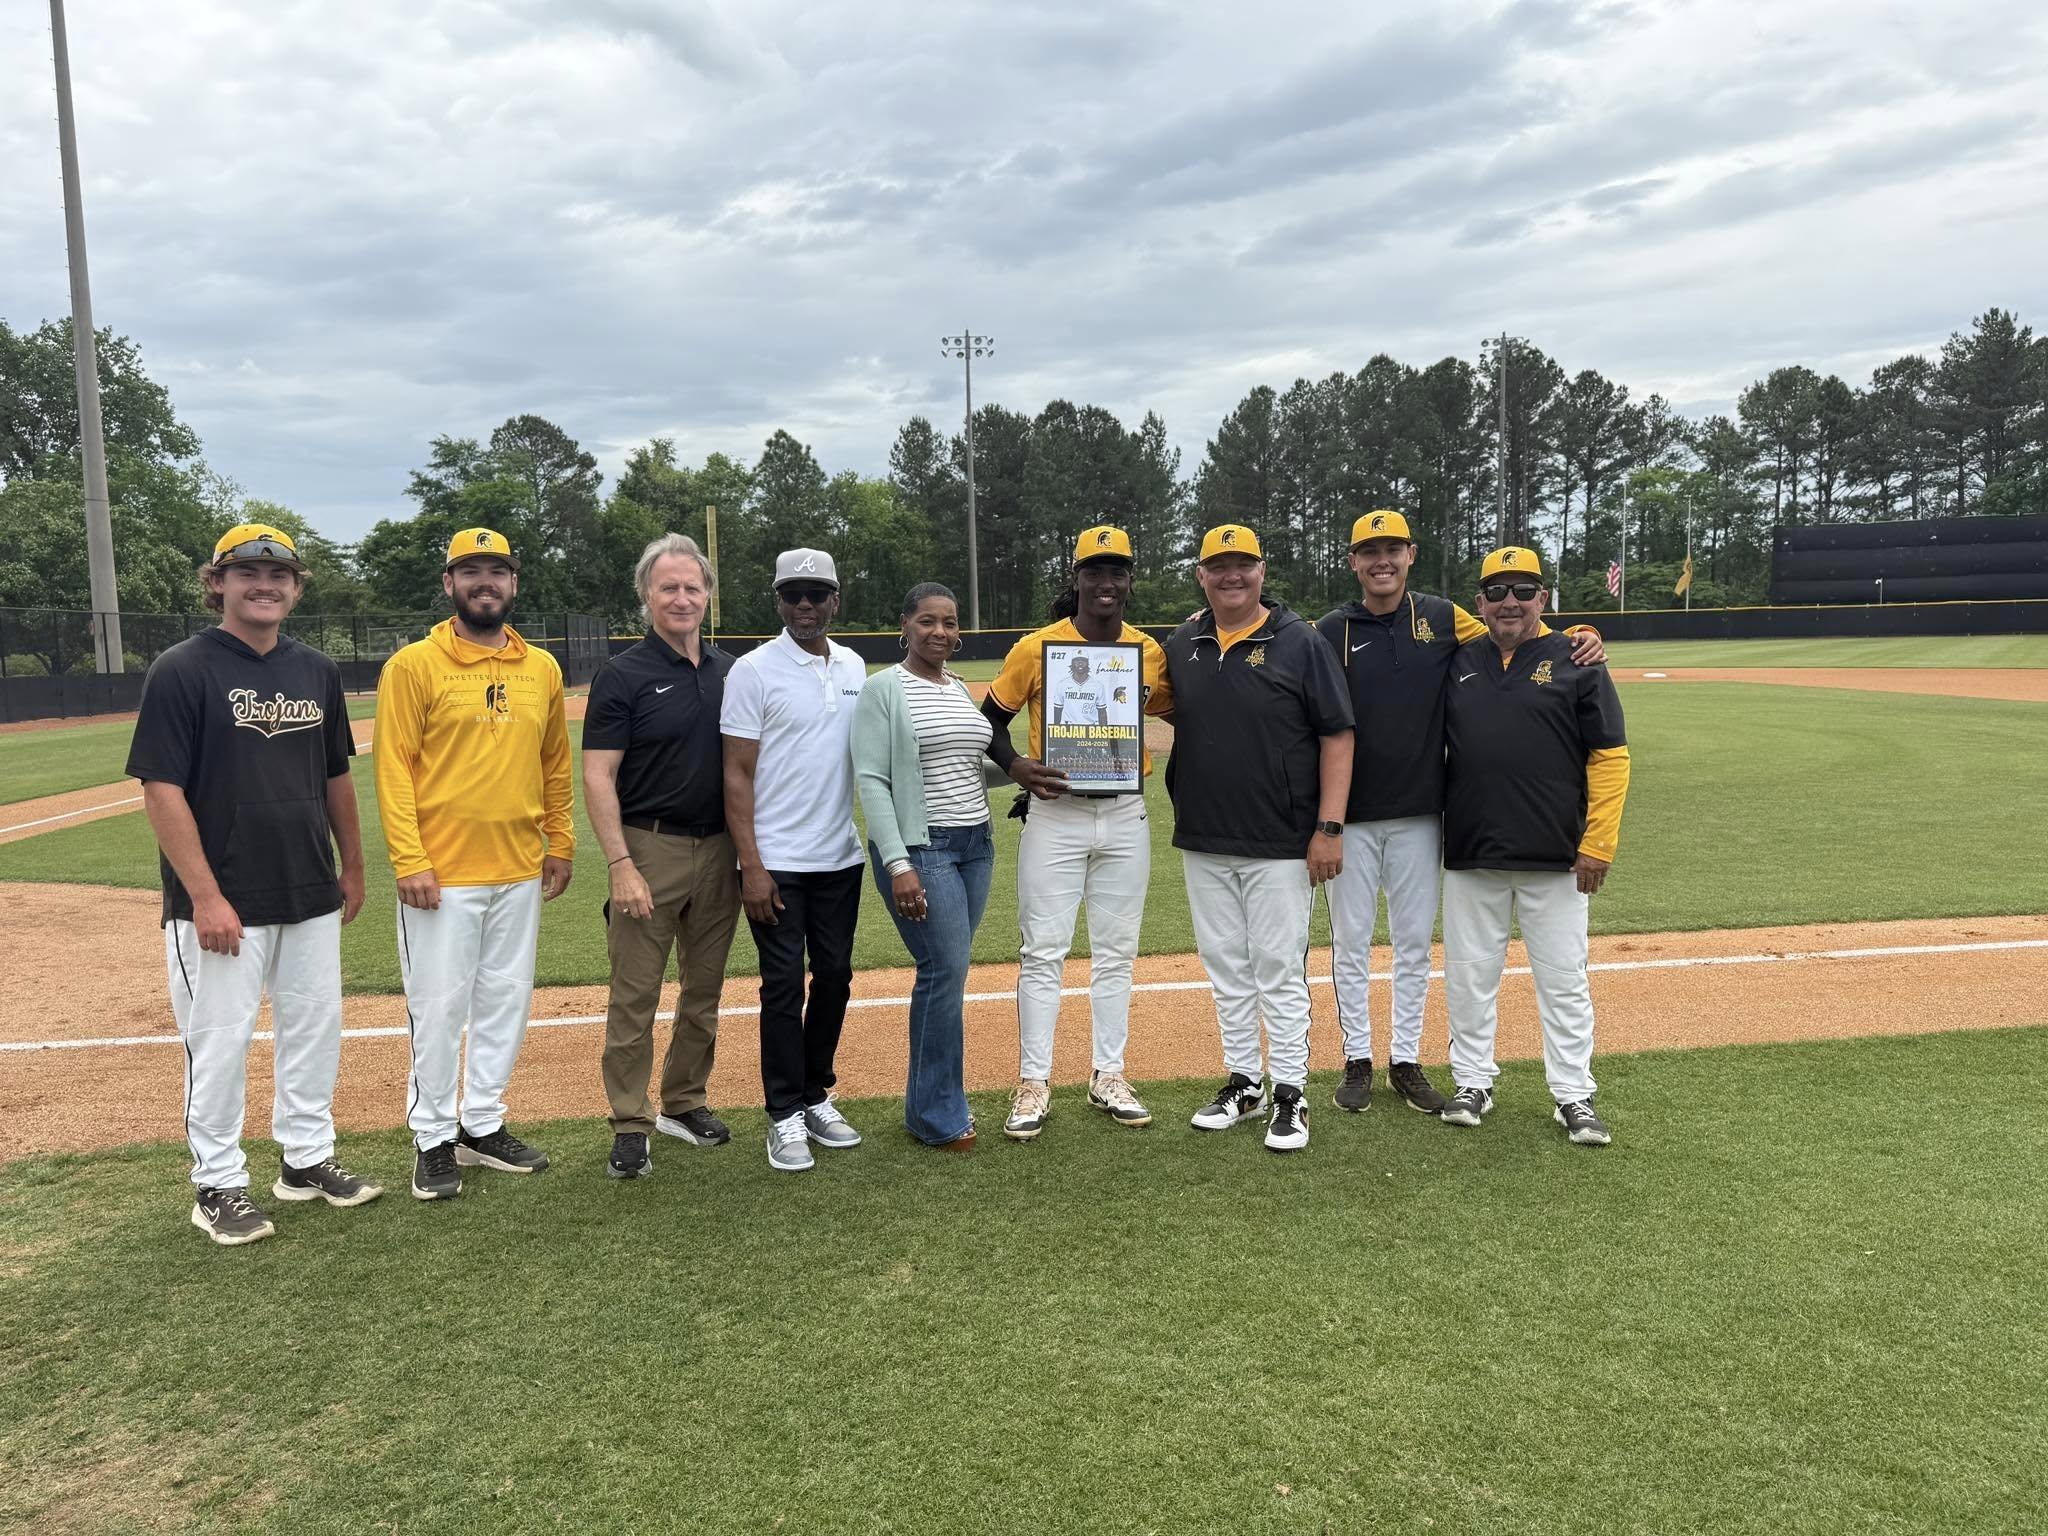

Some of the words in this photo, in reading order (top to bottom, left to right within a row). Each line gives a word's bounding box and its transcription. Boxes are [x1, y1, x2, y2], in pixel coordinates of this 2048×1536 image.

[794, 555, 816, 573] A
[1051, 652, 1066, 660] #27
[444, 674, 511, 682] FAYETTEVLLE
[228, 688, 321, 731] Trojans
[1048, 725, 1086, 739] TROJAN
[1088, 725, 1137, 739] BASEBALL
